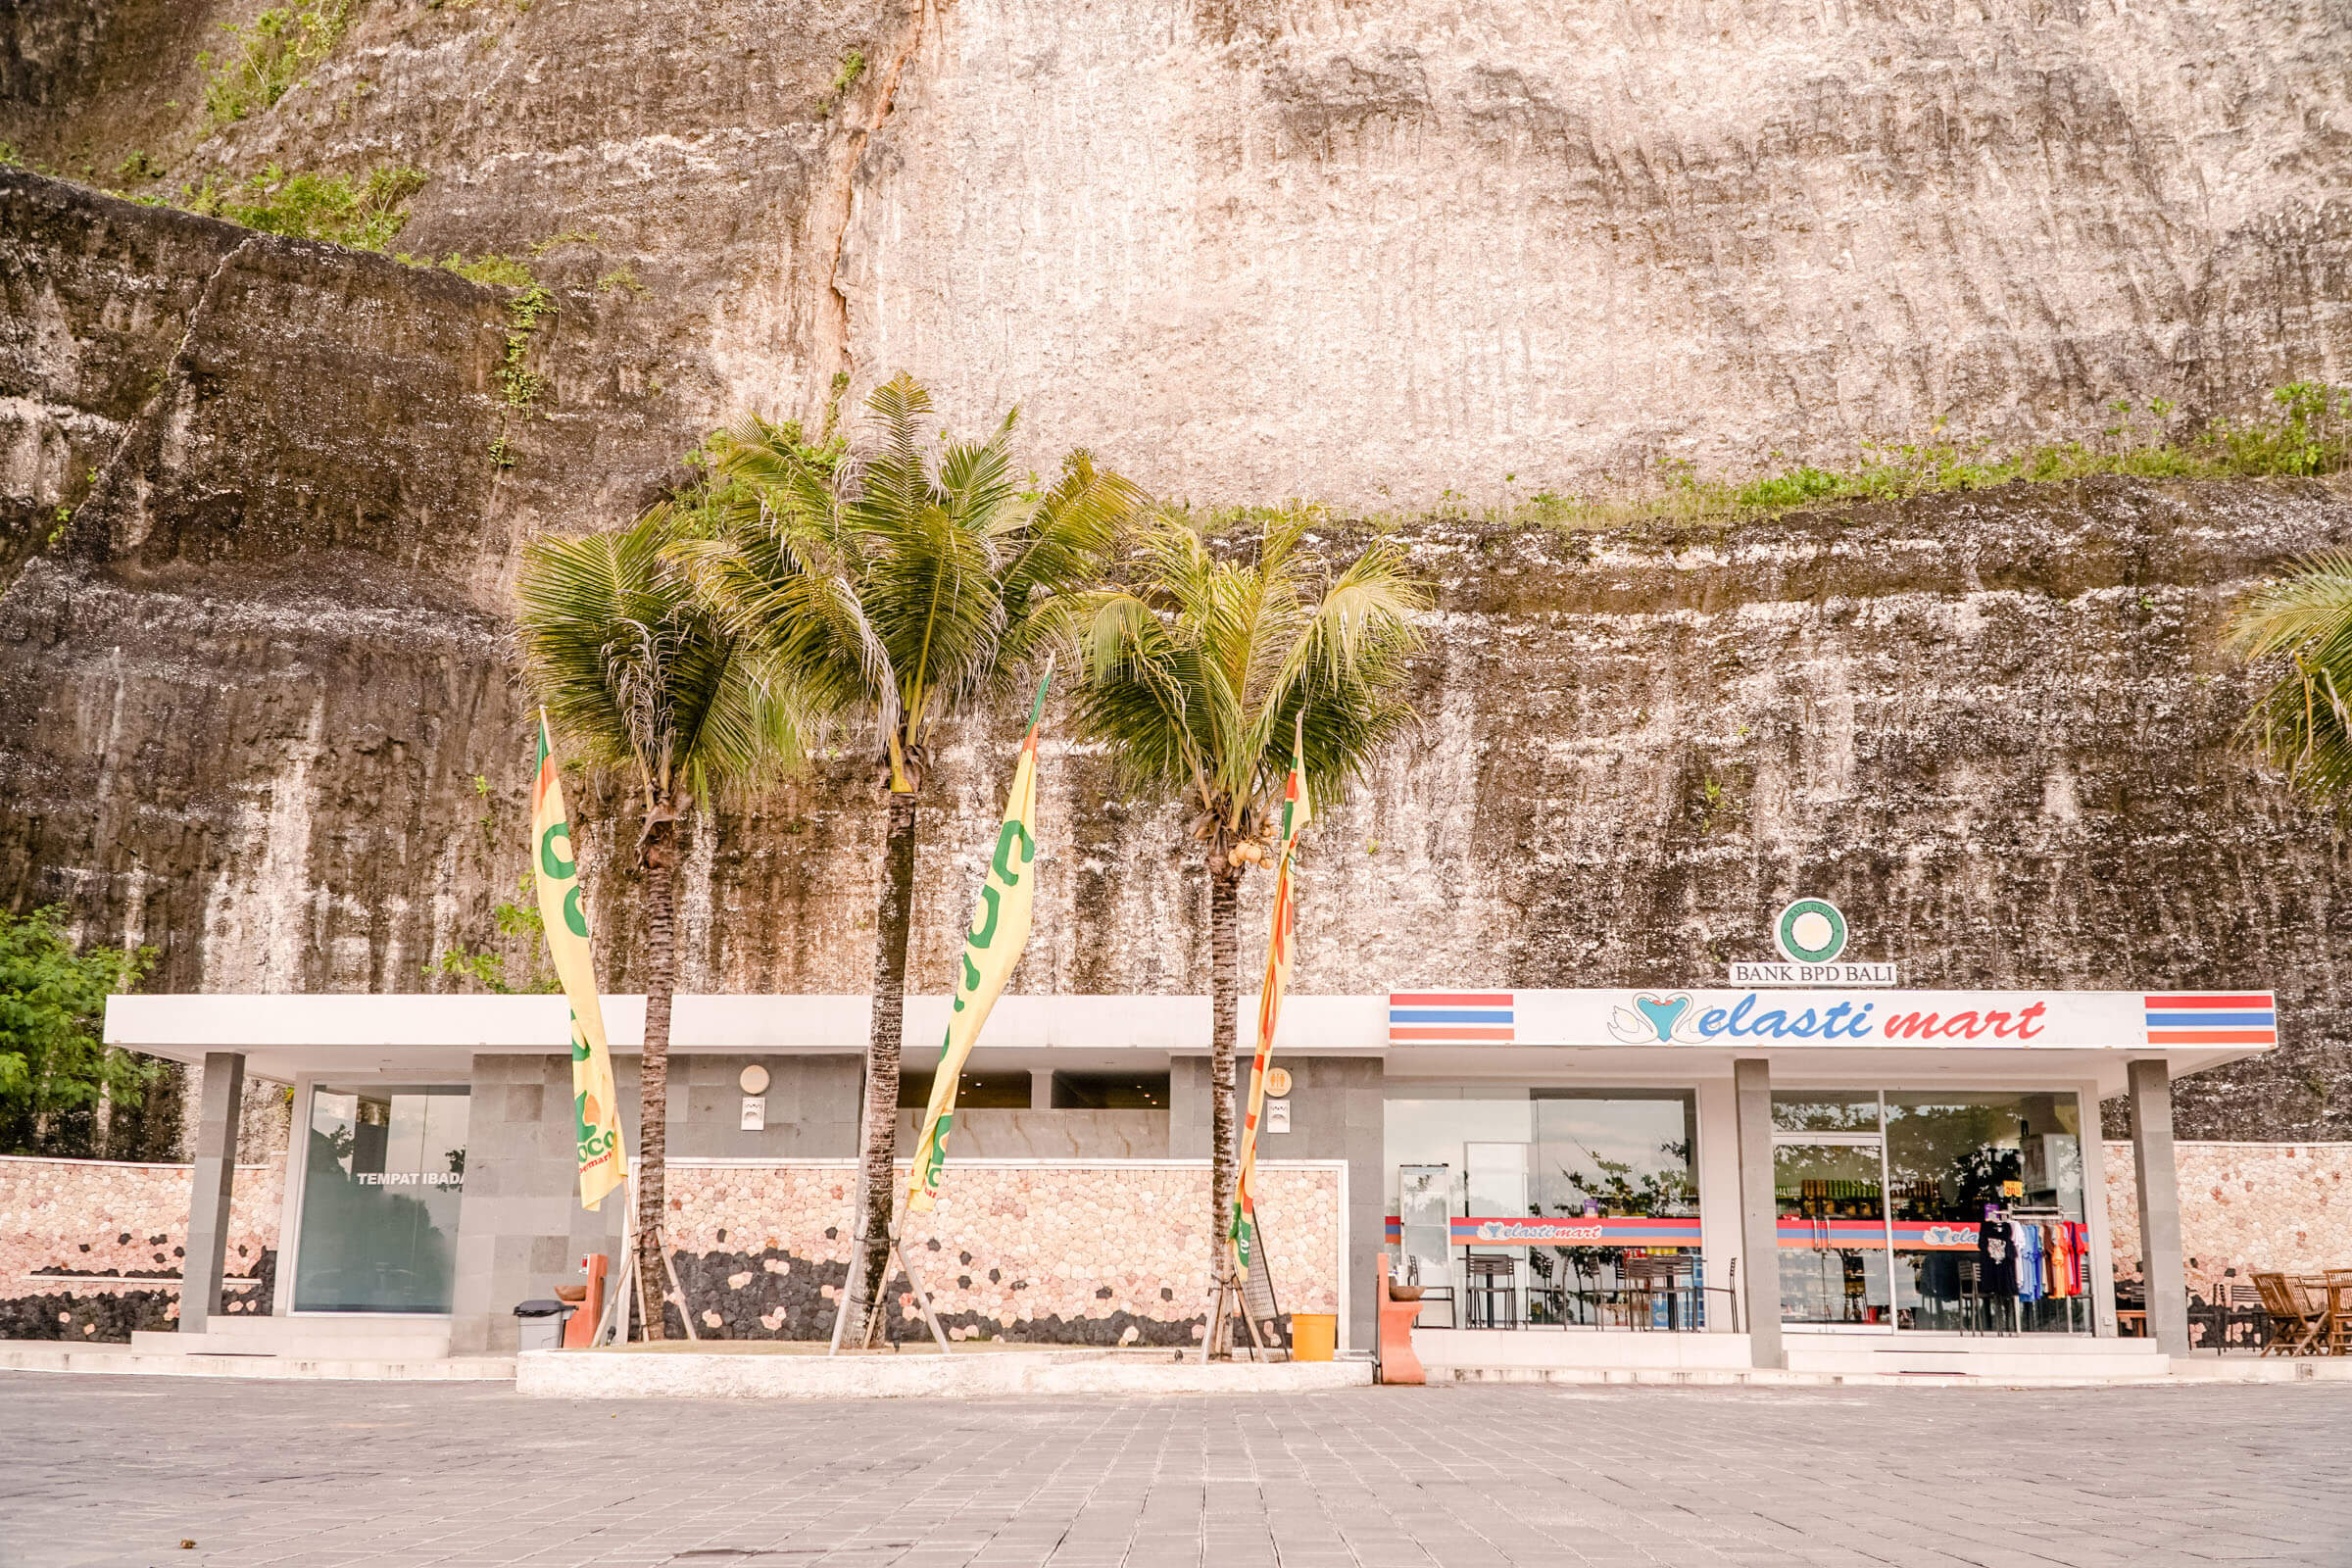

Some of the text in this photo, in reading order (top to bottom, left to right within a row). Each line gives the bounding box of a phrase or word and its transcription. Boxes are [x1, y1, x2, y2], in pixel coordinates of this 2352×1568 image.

[1737, 966, 1893, 981] BANK BPD BALI
[1884, 1001, 2047, 1040] mart
[357, 1172, 419, 1185] TEMPAT
[1555, 1226, 1601, 1239] mart
